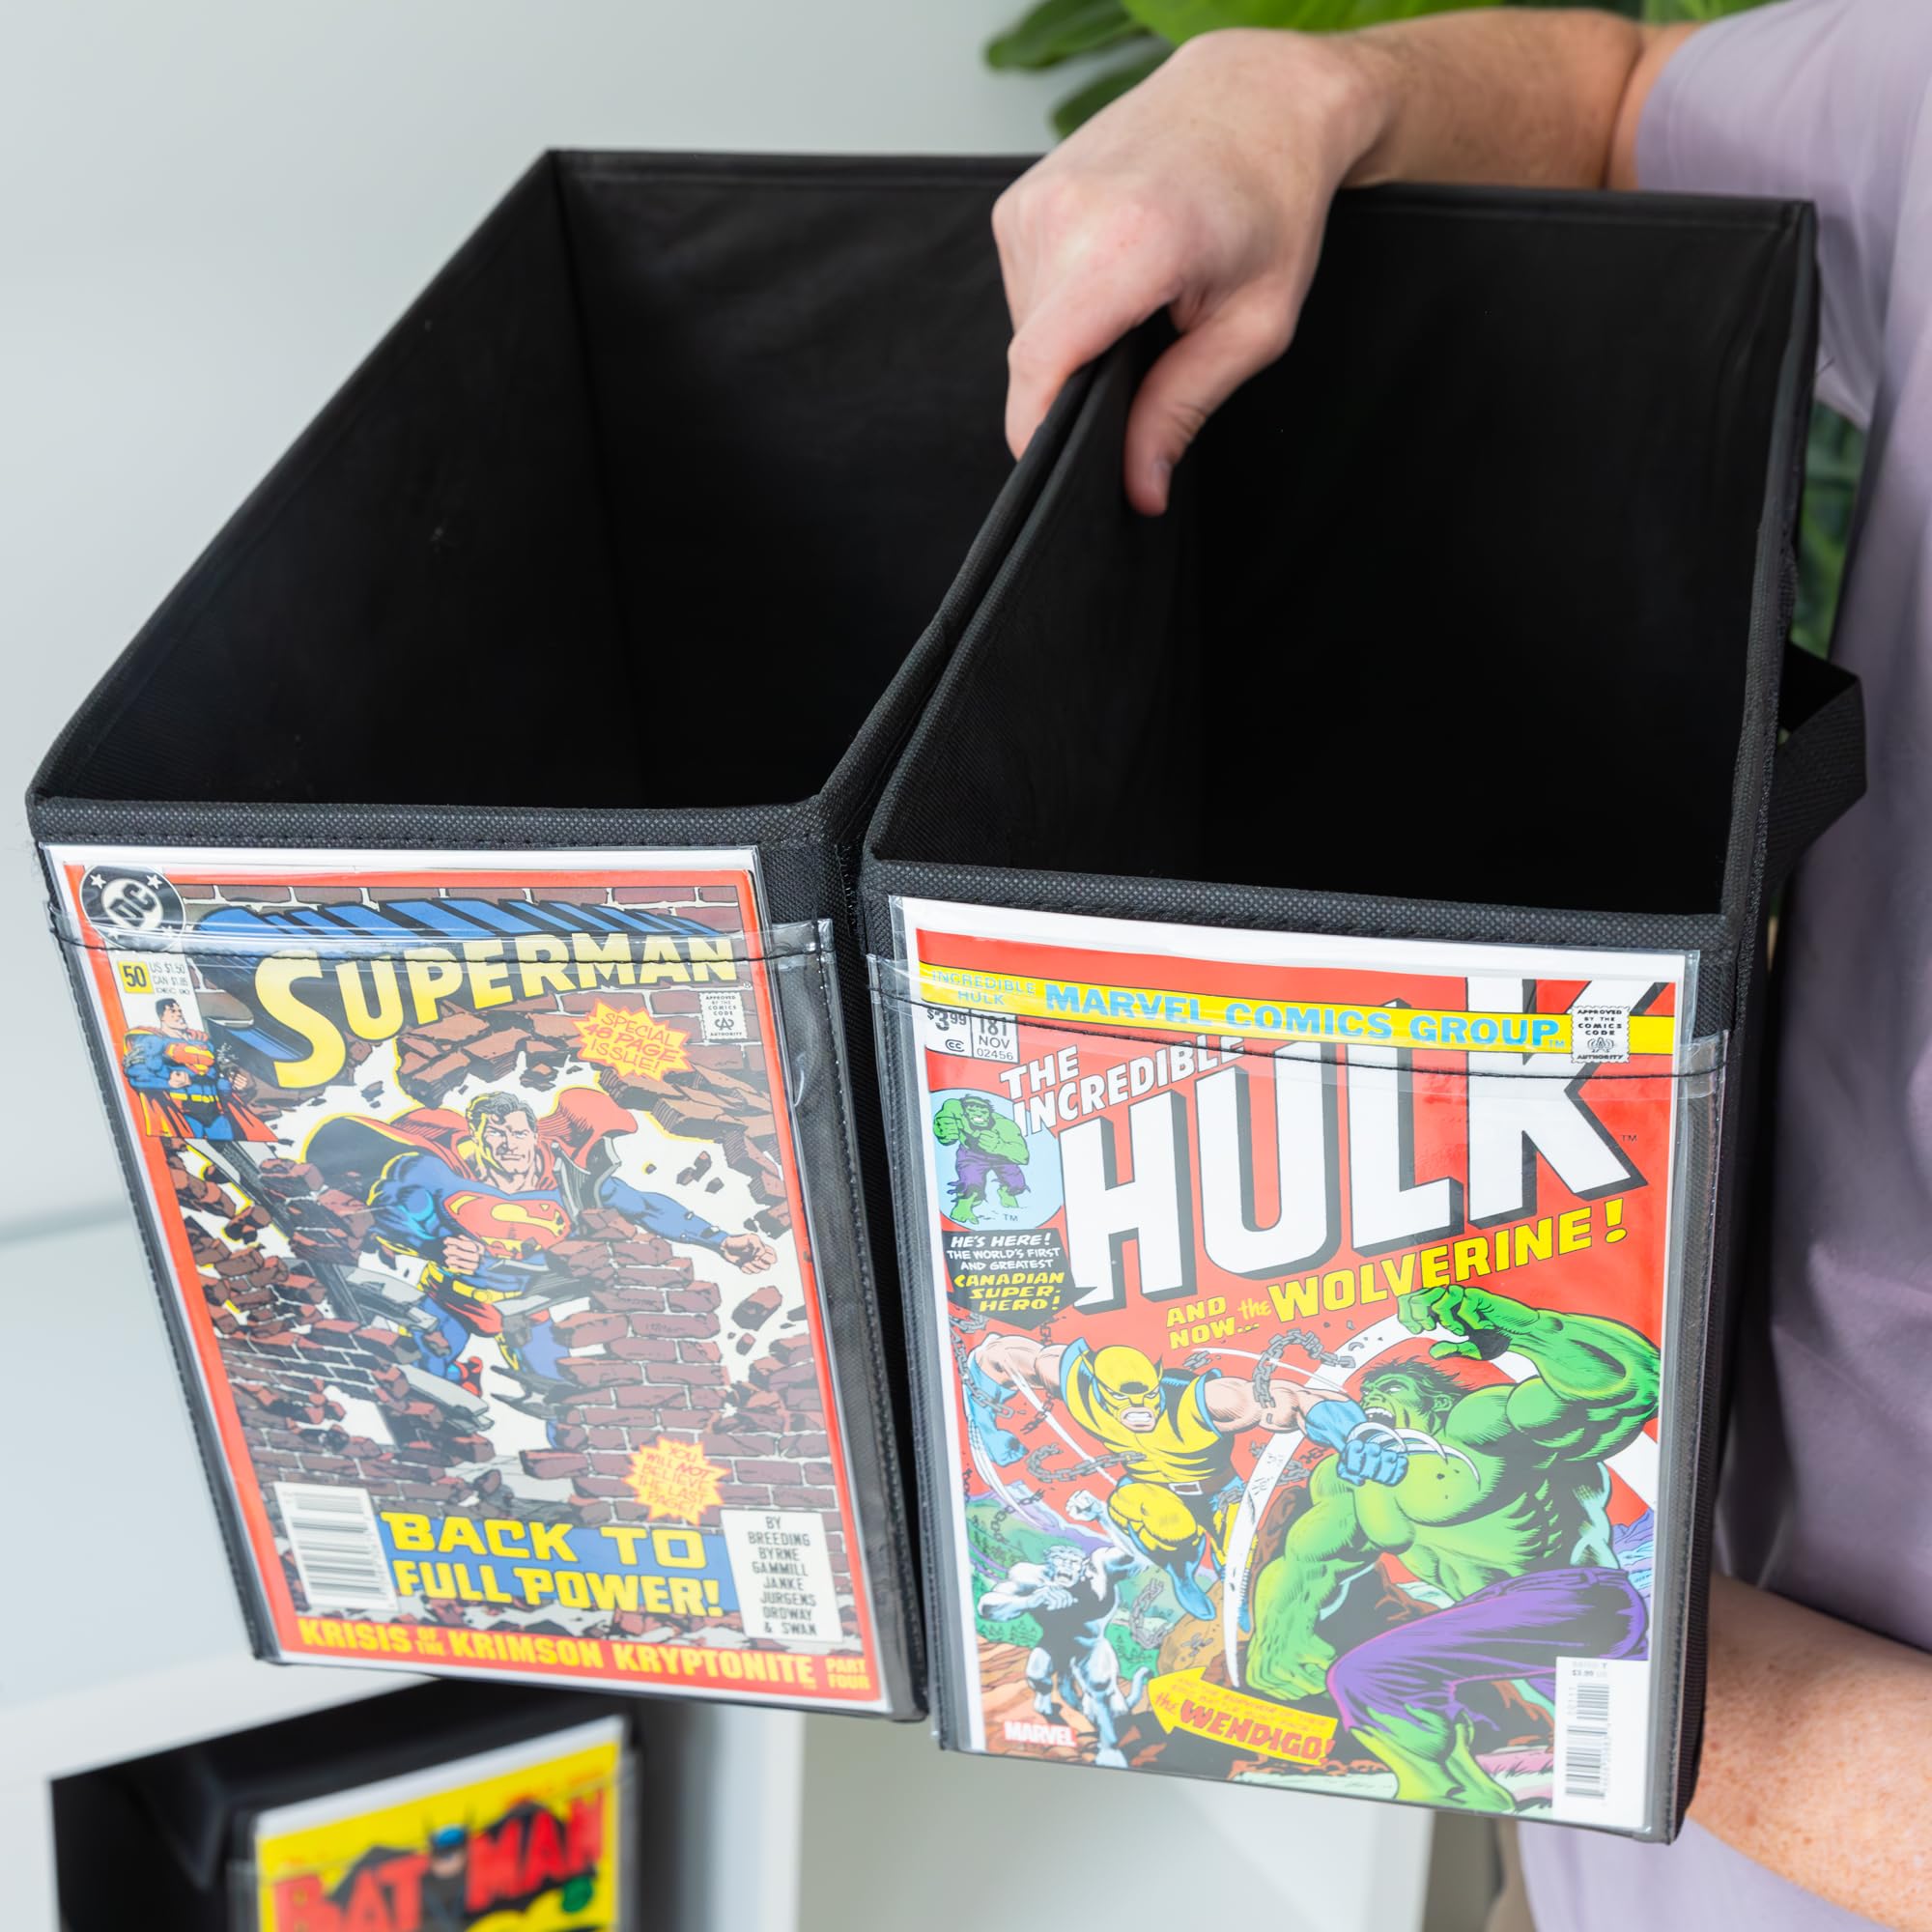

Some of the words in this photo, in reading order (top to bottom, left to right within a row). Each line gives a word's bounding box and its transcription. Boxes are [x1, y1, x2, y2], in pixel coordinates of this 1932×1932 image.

[109, 884, 156, 928] DC
[123, 965, 147, 987] 50
[931, 970, 1037, 996] INCREDIBLE
[1045, 983, 1212, 1026] MARVEL
[1226, 1003, 1392, 1037] COMICS
[1410, 1014, 1559, 1046] GROUP
[957, 991, 1005, 1006] HULK
[255, 933, 737, 1089] SUPERMAN
[601, 1012, 675, 1048] SPECIAL
[980, 1014, 1007, 1036] 181
[614, 1033, 679, 1062] PAGE
[979, 1036, 1010, 1050] NOV
[590, 1038, 661, 1073] ISSUE!
[977, 1048, 1013, 1061] 02456
[999, 1044, 1079, 1099] THE
[1012, 1035, 1246, 1137] INCREDIBLE
[1061, 977, 1669, 1315] HULK
[951, 1236, 986, 1248] HE'S
[990, 1233, 1051, 1247] HERE!
[946, 1250, 971, 1260] THE
[973, 1248, 1025, 1260] WORLD'S
[1026, 1247, 1061, 1258] FIRST
[1237, 1297, 1272, 1321] the
[1267, 1198, 1629, 1322] WOLVERINE!
[960, 1262, 986, 1270] AND
[989, 1259, 1054, 1270] GREATEST
[953, 1271, 1065, 1288] CANADIAN
[969, 1286, 1061, 1299] SUPER-
[980, 1295, 1061, 1312] HERO!
[1166, 1295, 1227, 1328] AND
[677, 1462, 711, 1478] NOT
[765, 1516, 781, 1529] BY
[380, 1511, 578, 1562] BACK
[599, 1525, 707, 1569] TO
[748, 1531, 810, 1547] BREEDING
[758, 1547, 800, 1561] BYRNE
[752, 1561, 809, 1577] GAMMILL
[392, 1560, 513, 1604] FULL
[513, 1567, 724, 1617] POWER!
[763, 1577, 804, 1591] JANKE
[760, 1591, 816, 1606] JURGENS
[763, 1606, 811, 1620] ORDWAY
[781, 1622, 817, 1635] SWAN
[298, 1619, 412, 1653] KRISIS
[448, 1631, 604, 1668] KRIMSON
[611, 1643, 816, 1685] KRYPTONITE
[825, 1658, 866, 1673] PART
[1005, 1720, 1077, 1747] MARVEL
[1180, 1699, 1336, 1764] WENDIGO!
